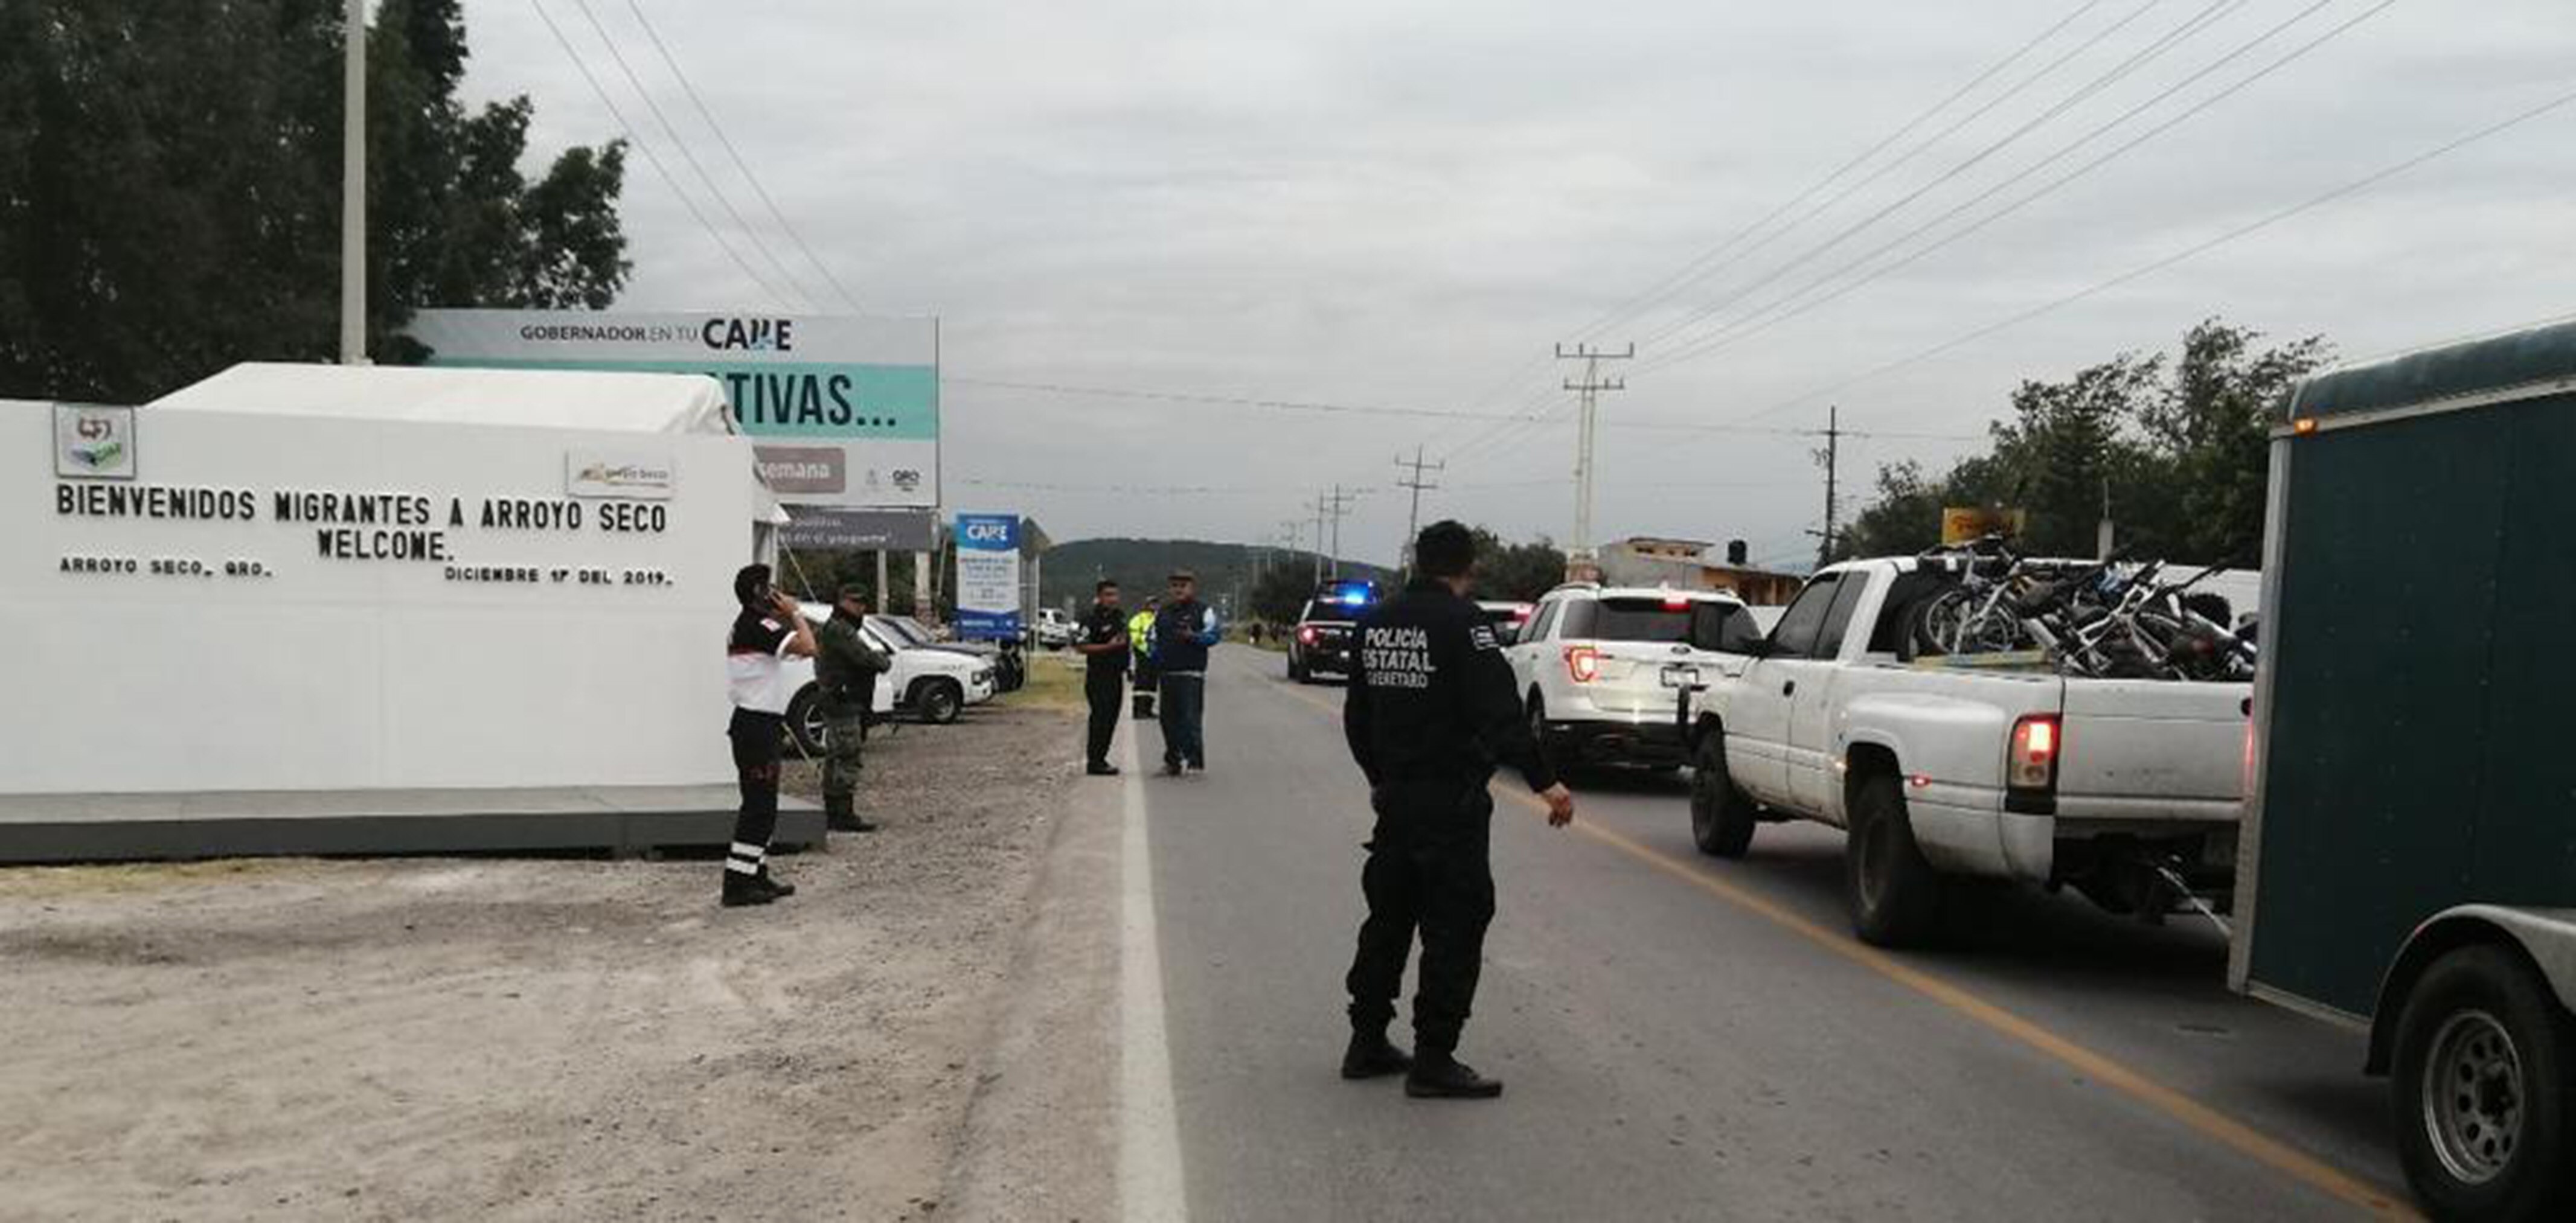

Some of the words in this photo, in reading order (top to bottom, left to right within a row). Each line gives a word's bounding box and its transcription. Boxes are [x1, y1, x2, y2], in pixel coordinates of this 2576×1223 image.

[520, 324, 646, 342] GOBERNADOR
[650, 326, 671, 341] EN
[677, 326, 698, 341] TU
[705, 372, 896, 426] TIVAS...
[56, 483, 255, 521] BIENVENIDOS
[274, 491, 430, 525] MIGRANTES
[449, 498, 464, 528] A
[480, 499, 583, 530] ARROYO
[600, 503, 666, 533] SECO
[317, 529, 455, 561] WELCOME.
[60, 557, 137, 573] ARROYO
[225, 560, 272, 577] QRO.
[444, 566, 540, 583] DICIEMBRE
[578, 570, 612, 585] DEL
[623, 570, 673, 586] 2019.
[1361, 648, 1437, 672] ESTATAL
